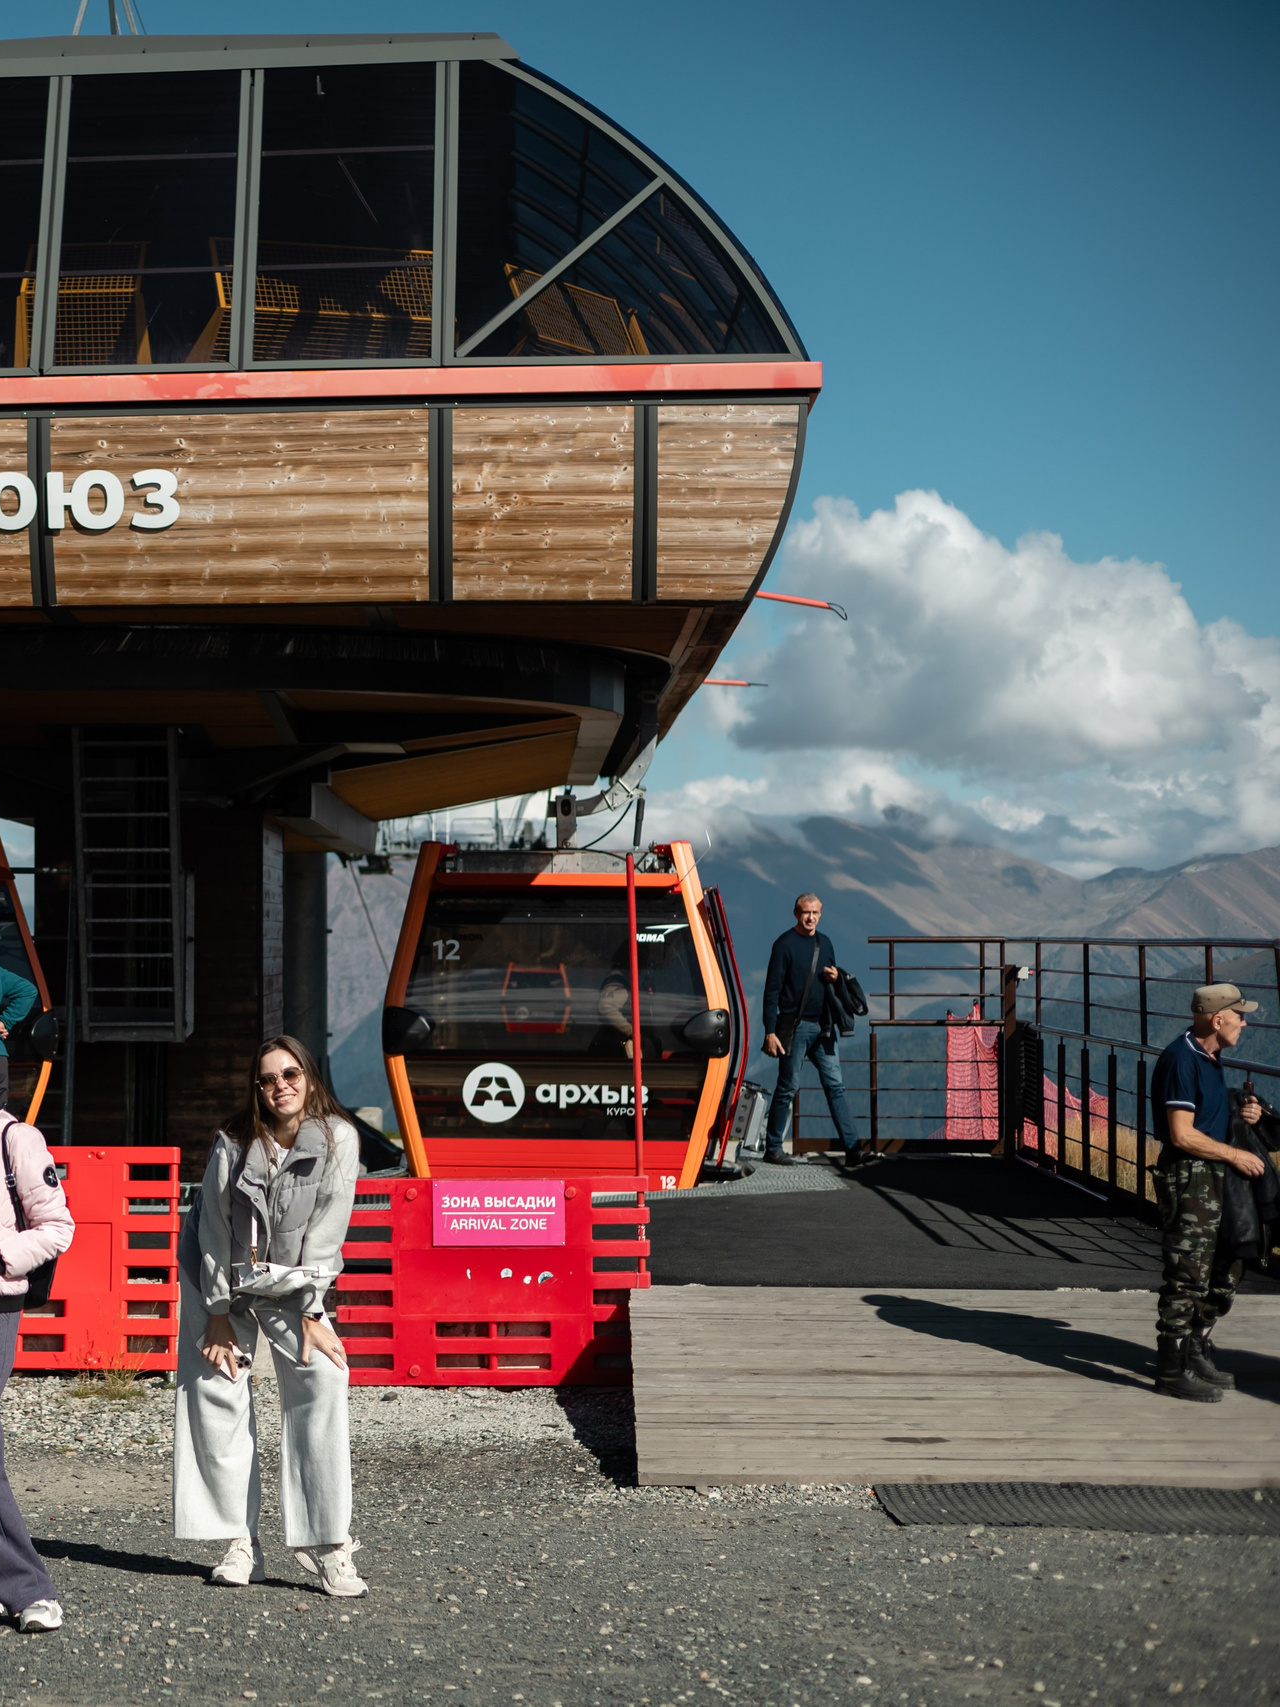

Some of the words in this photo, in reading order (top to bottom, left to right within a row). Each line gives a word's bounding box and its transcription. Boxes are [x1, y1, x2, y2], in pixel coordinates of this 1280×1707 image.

[432, 938, 461, 961] 12
[535, 1083, 649, 1109] архыз
[606, 1107, 649, 1117] КУРОТ
[660, 1175, 677, 1190] 12
[441, 1196, 480, 1208] ЗОНА
[484, 1196, 556, 1210] ВЫСАДКИ
[450, 1218, 507, 1230] ARRIVAL
[509, 1218, 548, 1230] ZONE
